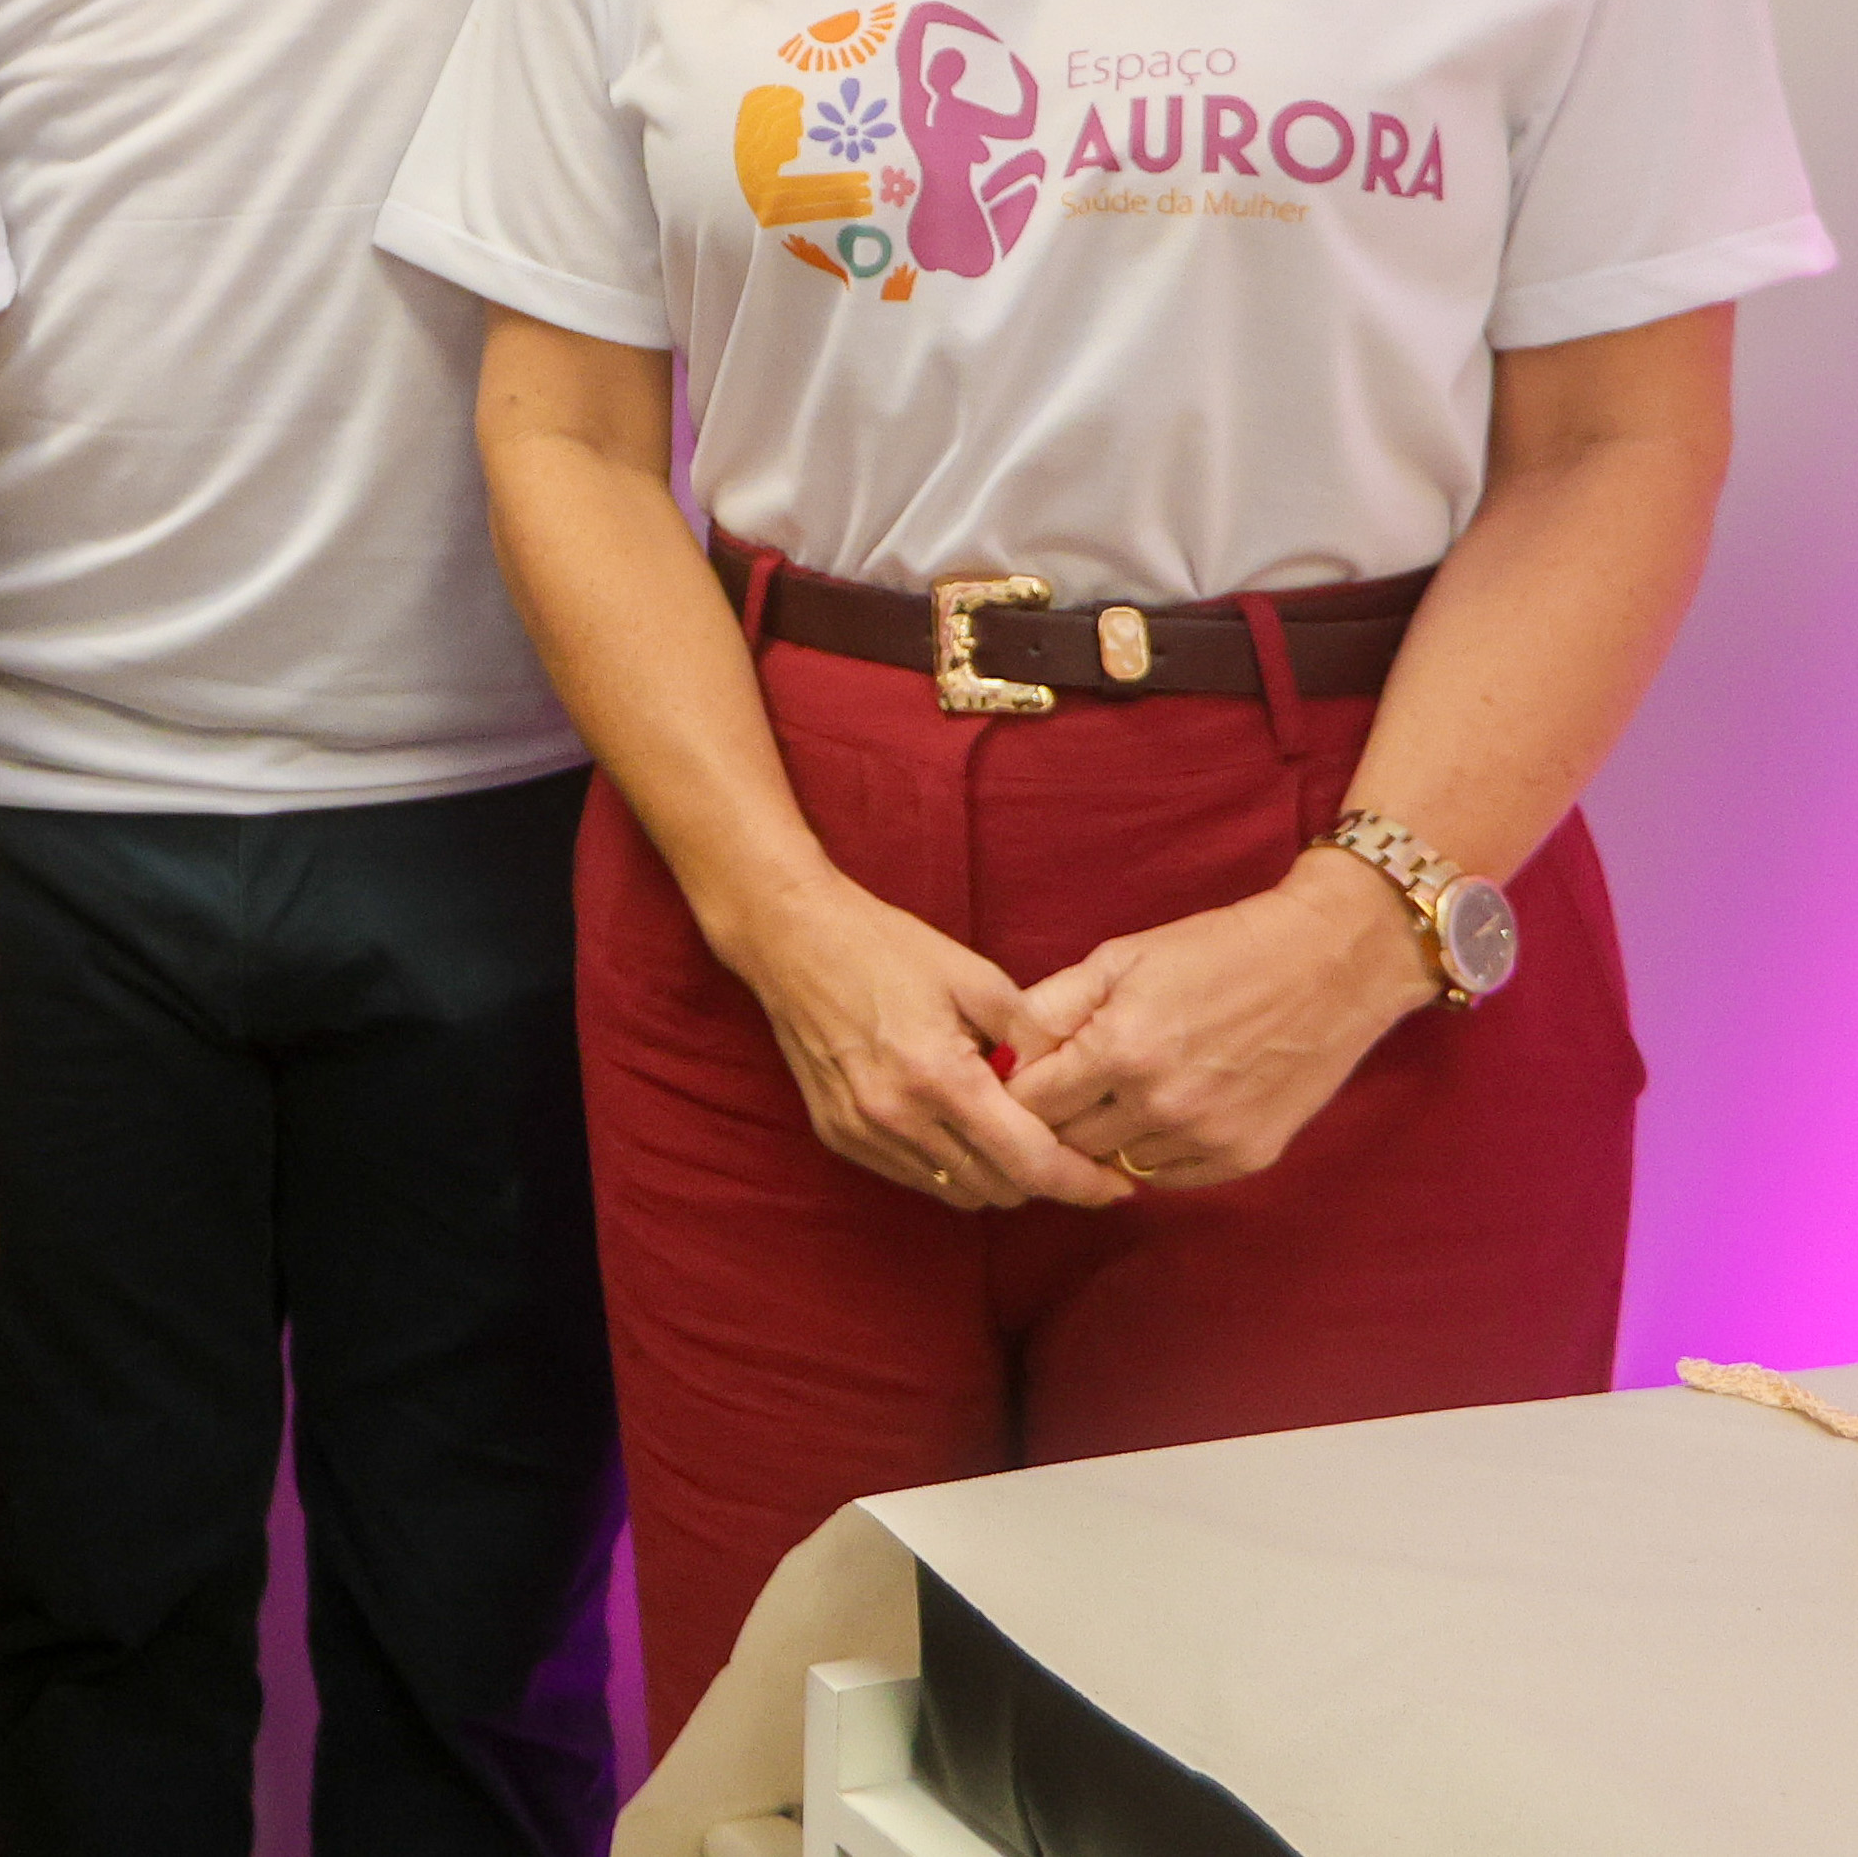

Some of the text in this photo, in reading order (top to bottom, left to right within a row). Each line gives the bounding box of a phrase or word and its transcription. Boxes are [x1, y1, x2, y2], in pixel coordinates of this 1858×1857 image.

[1066, 48, 1237, 90] Espaço
[1063, 94, 1445, 202] AURORA
[1061, 188, 1310, 223] Saúde da Mulher
